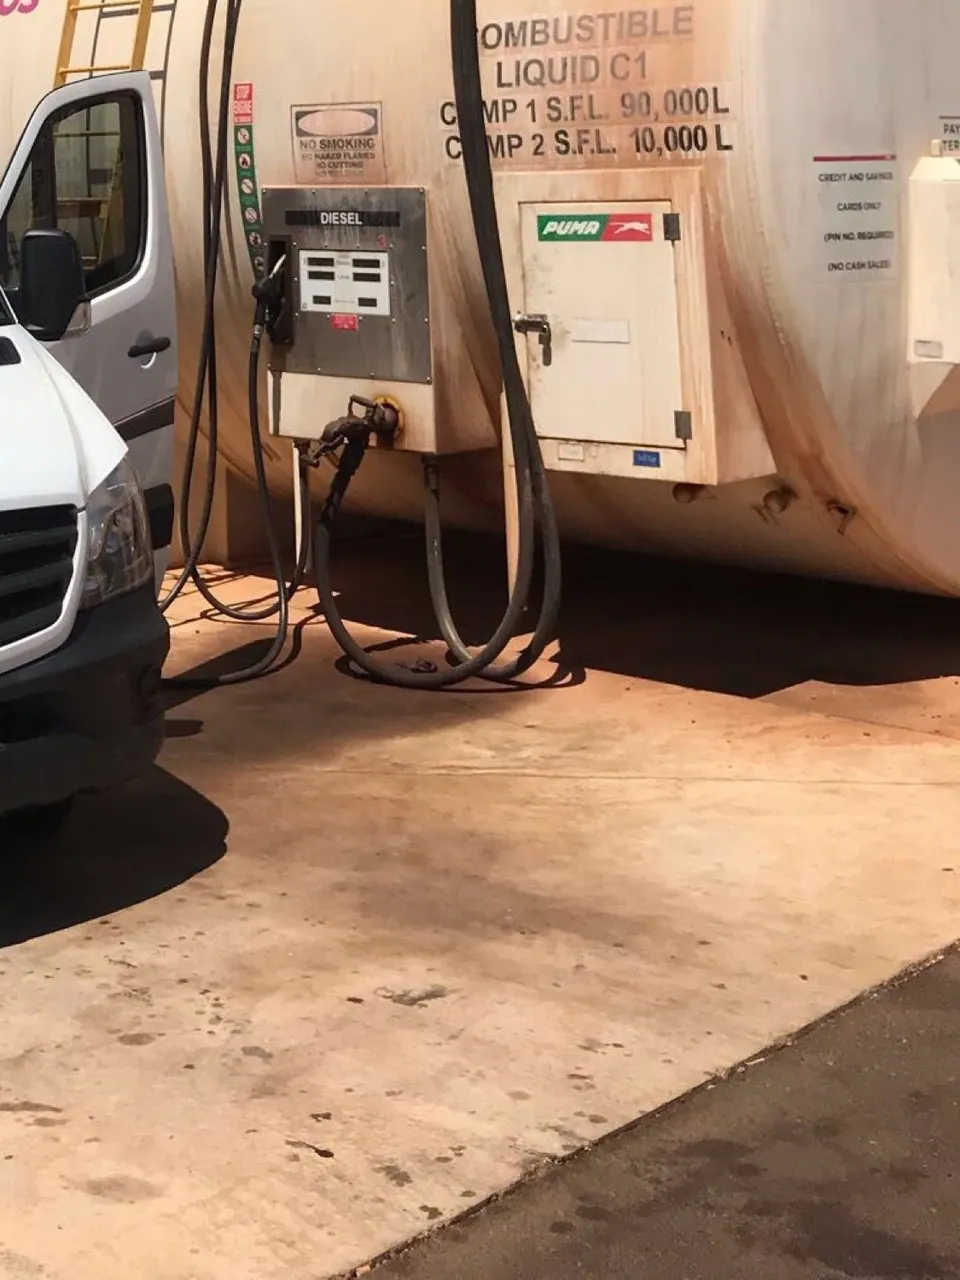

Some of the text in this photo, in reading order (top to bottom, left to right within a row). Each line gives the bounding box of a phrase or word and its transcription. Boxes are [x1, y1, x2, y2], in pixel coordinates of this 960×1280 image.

[477, 6, 694, 49] OMBUSTIBLE
[496, 52, 647, 88] LIQUID C1
[440, 98, 517, 125] CMP
[525, 100, 537, 124] 1
[300, 138, 375, 150] NO SMOKING
[445, 134, 523, 160] CMP
[532, 133, 545, 155] 2
[554, 125, 617, 156] S.F.L.
[818, 173, 846, 183] CREDIT
[849, 173, 864, 182] AND
[837, 202, 862, 212] CARDS
[320, 212, 362, 225] DIESEL
[542, 221, 600, 235] PUMA
[828, 262, 844, 272] (NO
